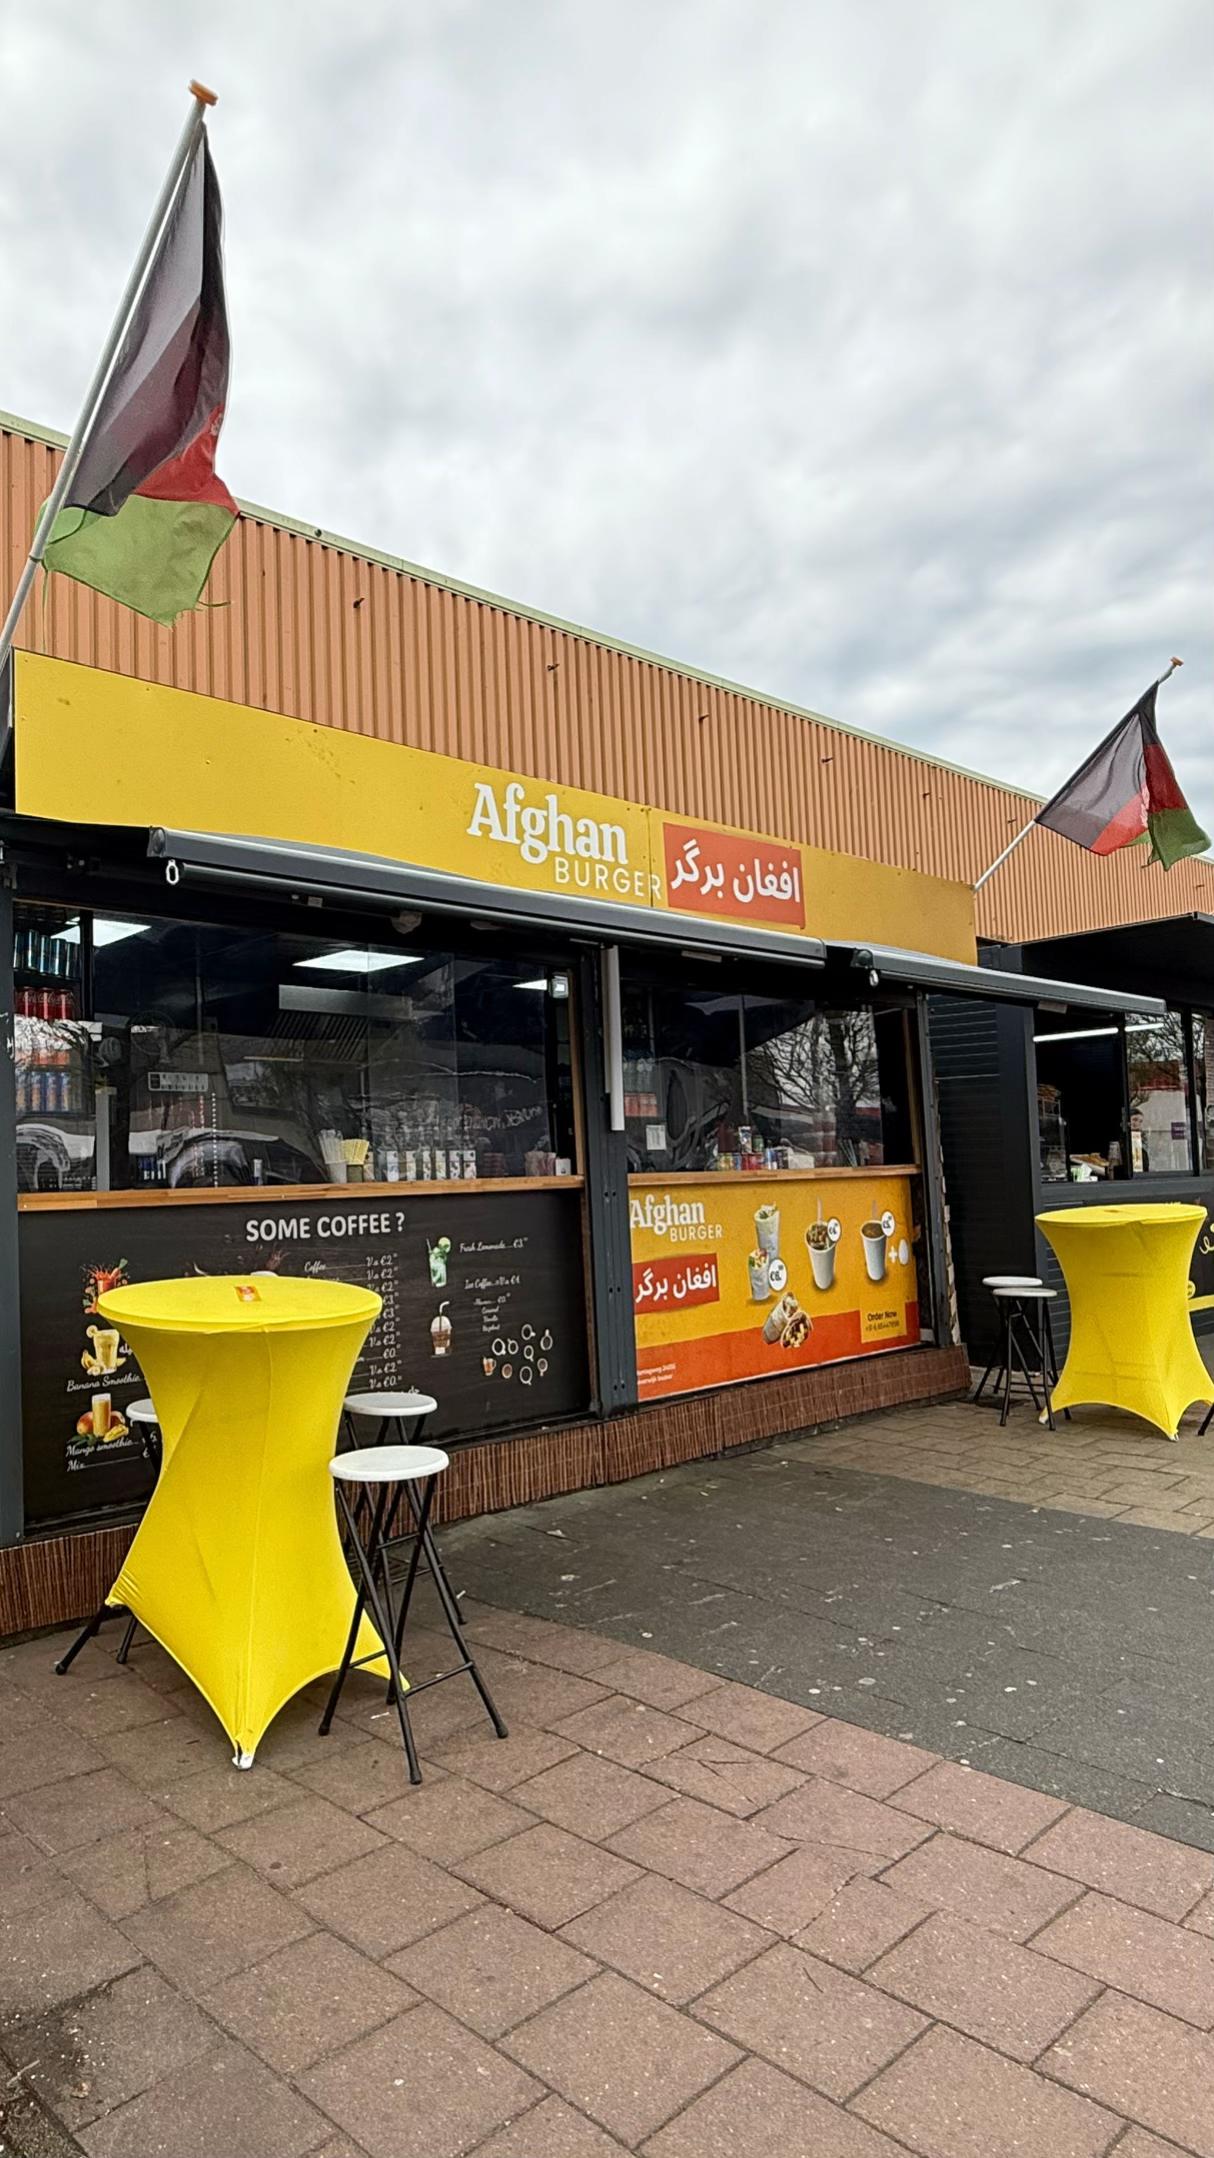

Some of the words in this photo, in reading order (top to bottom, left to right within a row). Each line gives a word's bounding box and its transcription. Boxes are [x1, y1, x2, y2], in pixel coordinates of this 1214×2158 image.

[466, 782, 629, 864] Afghan
[554, 856, 662, 900] BURGER
[670, 838, 724, 899] برگر
[732, 857, 800, 903] افغان
[246, 1217, 311, 1242] SOME
[317, 1212, 391, 1238] COFFEE
[629, 1193, 705, 1235] Afghan
[669, 1223, 722, 1242] BURGER
[304, 1260, 326, 1274] Coffee
[635, 1267, 669, 1303] برگر
[673, 1262, 717, 1299] افغان
[66, 1379, 100, 1392] Banana
[102, 1373, 140, 1387] Smoothie
[65, 1445, 95, 1458] Mango
